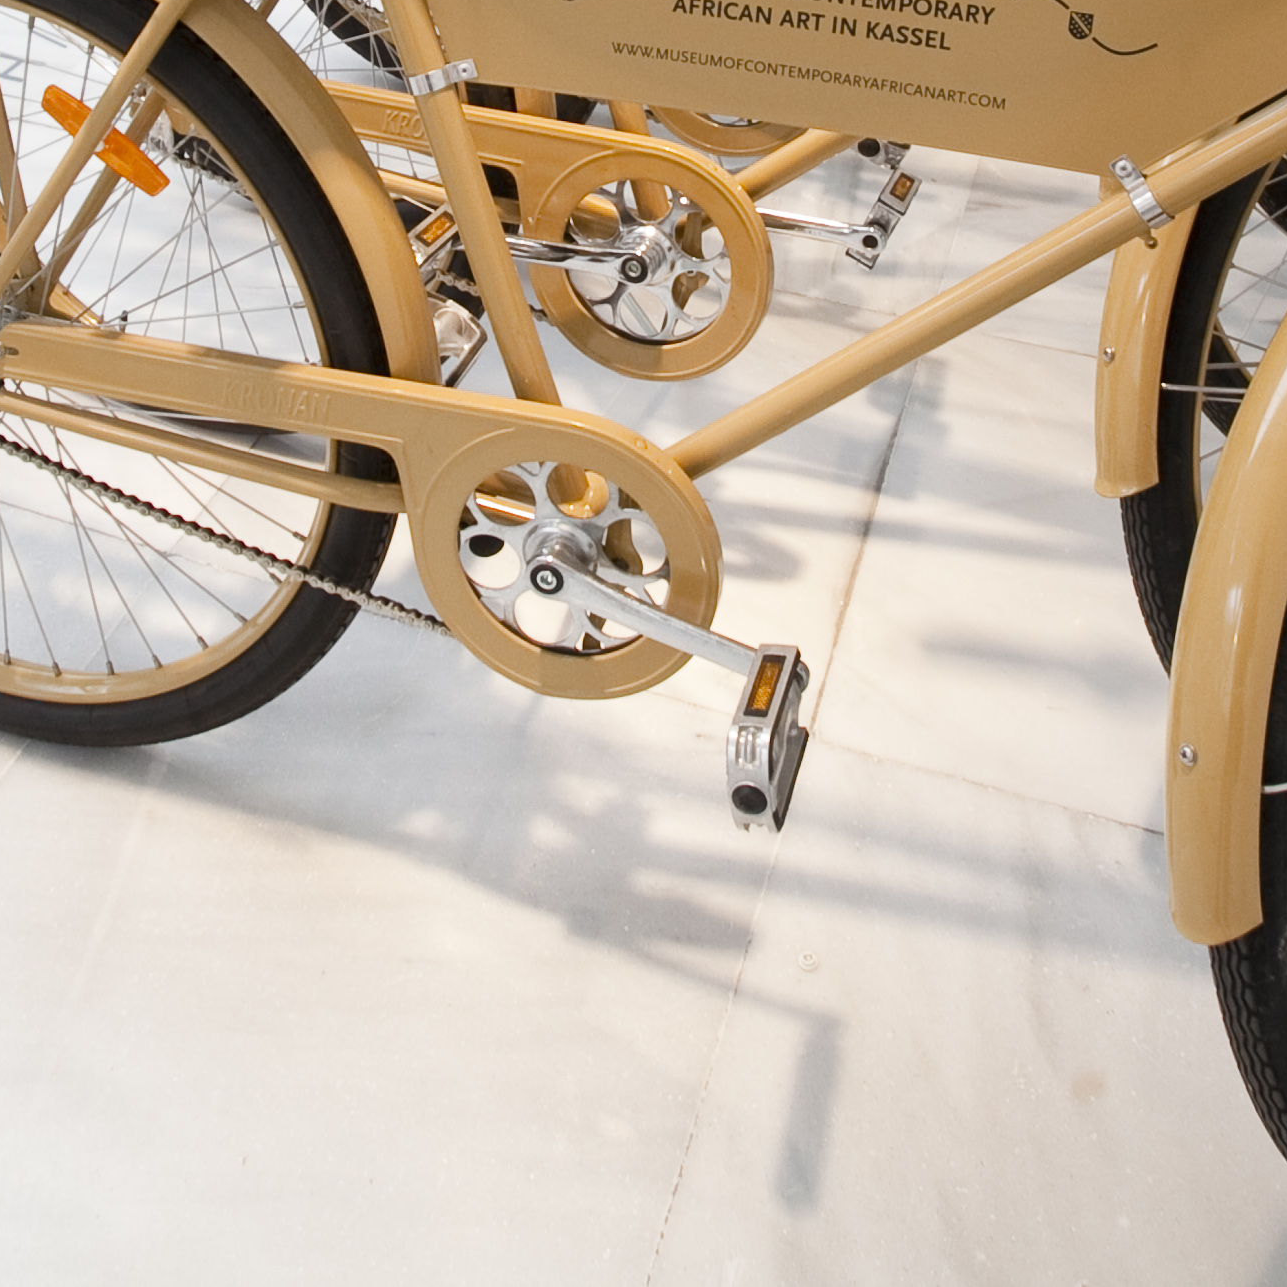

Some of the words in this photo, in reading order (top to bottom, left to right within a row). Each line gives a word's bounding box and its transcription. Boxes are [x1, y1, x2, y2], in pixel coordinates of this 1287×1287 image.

[779, 9, 825, 32] ART
[831, 16, 858, 37] IN
[865, 20, 952, 51] KASSEL
[611, 40, 1007, 111] WWW.MUSEUMOFCONTEMPORARYAFRICANART.COM
[382, 109, 425, 138] KRO
[221, 377, 331, 423] KRONAN
